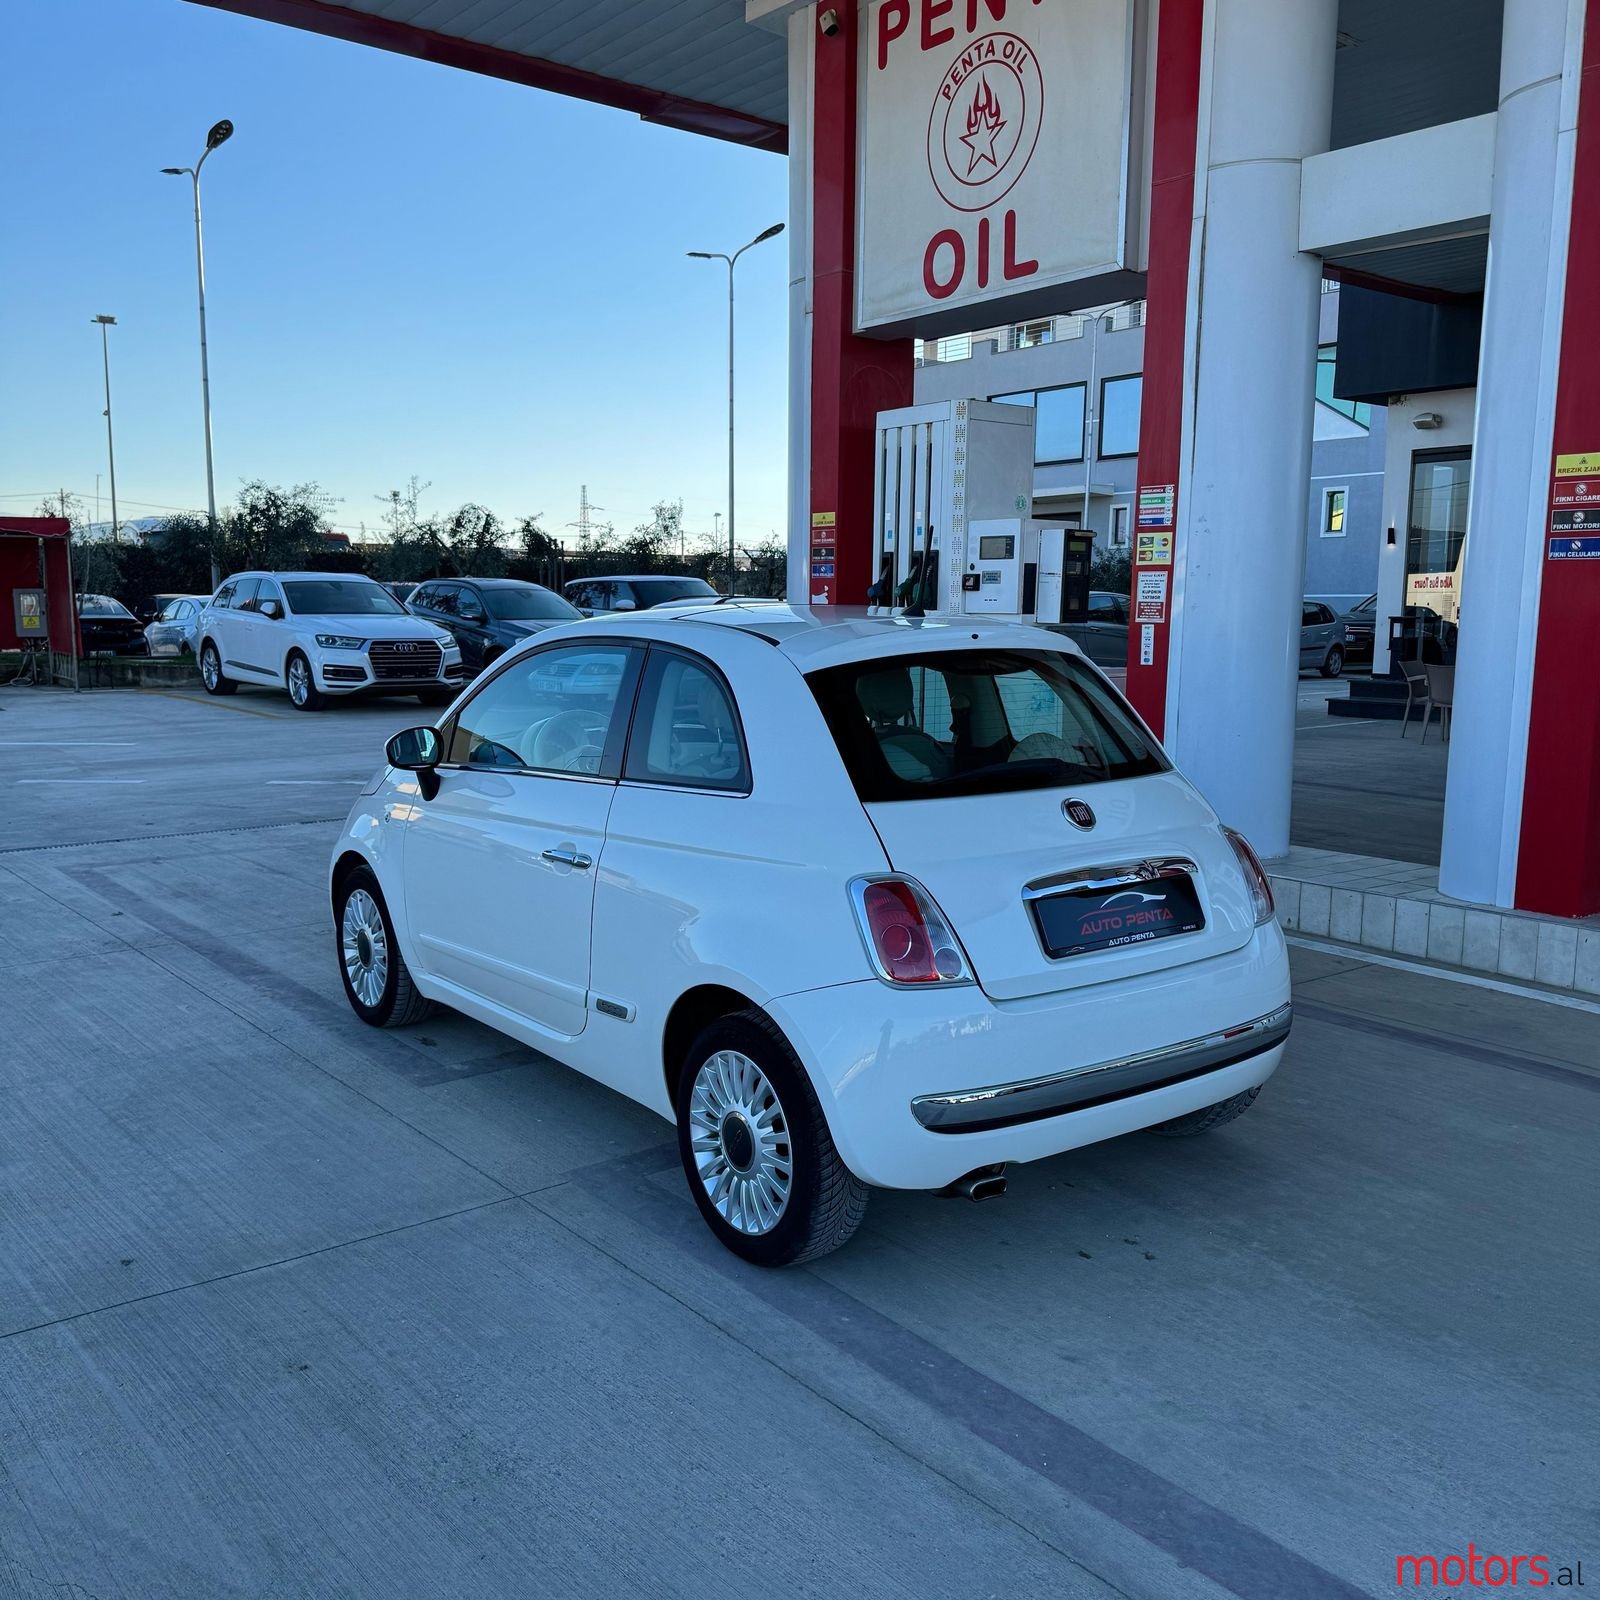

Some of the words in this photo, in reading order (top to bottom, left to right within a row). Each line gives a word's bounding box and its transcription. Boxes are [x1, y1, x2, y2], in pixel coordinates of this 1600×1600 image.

[942, 39, 996, 101] PENTA
[1002, 40, 1028, 75] OIL
[923, 209, 1040, 299] OIL
[1069, 805, 1091, 822] FIAT
[1080, 915, 1123, 936] AUTO
[1125, 908, 1175, 927] PENTA
[1108, 935, 1131, 947] AUTO
[1131, 931, 1156, 943] PENTA
